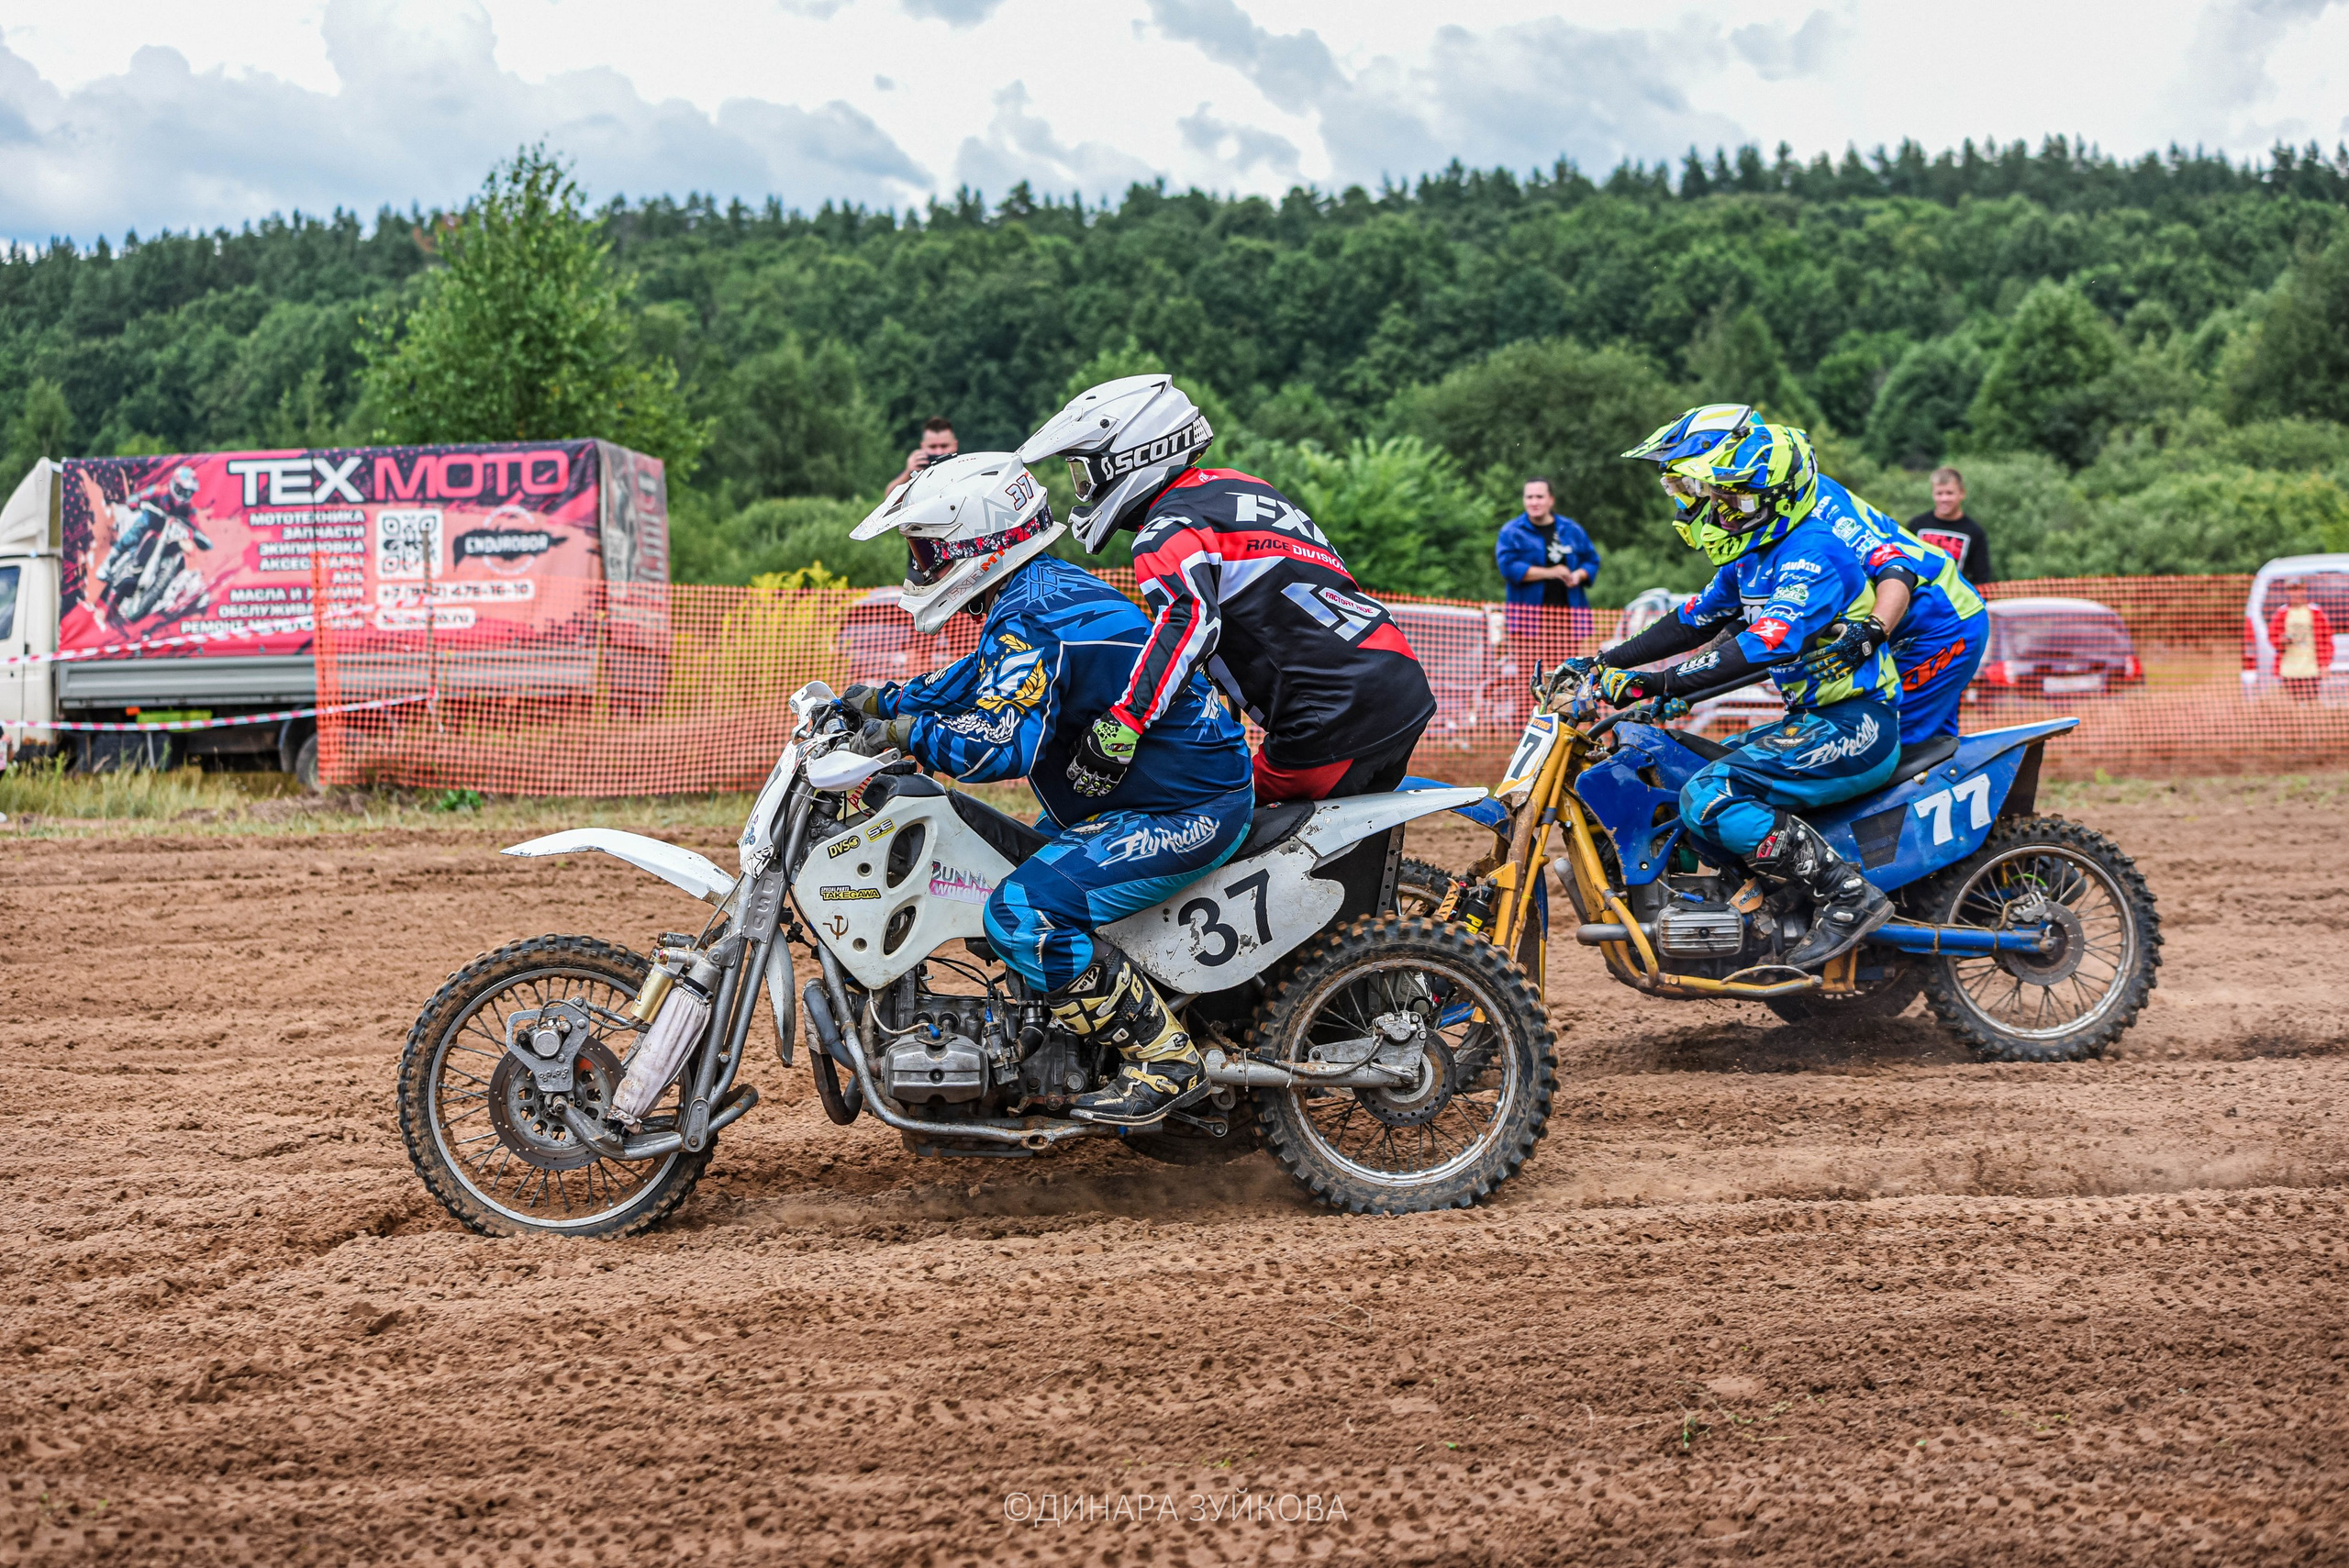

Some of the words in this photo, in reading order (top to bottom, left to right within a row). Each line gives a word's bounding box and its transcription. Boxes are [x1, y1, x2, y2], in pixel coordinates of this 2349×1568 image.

[1115, 425, 1193, 475] SCOTT
[1005, 474, 1034, 511] 37
[249, 509, 365, 526] МОТОТЕХНИКА
[282, 525, 365, 539] ЗАПЧАСТИ
[1246, 539, 1290, 551] RACE
[230, 588, 287, 603] МАСЛА
[289, 587, 303, 601] И
[1325, 591, 1354, 609] FACTORY
[1509, 732, 1543, 781] 7
[1913, 773, 1992, 846] 77
[829, 840, 850, 858] DVS
[822, 889, 879, 899] TAKEGAWA
[1177, 867, 1274, 967] 37
